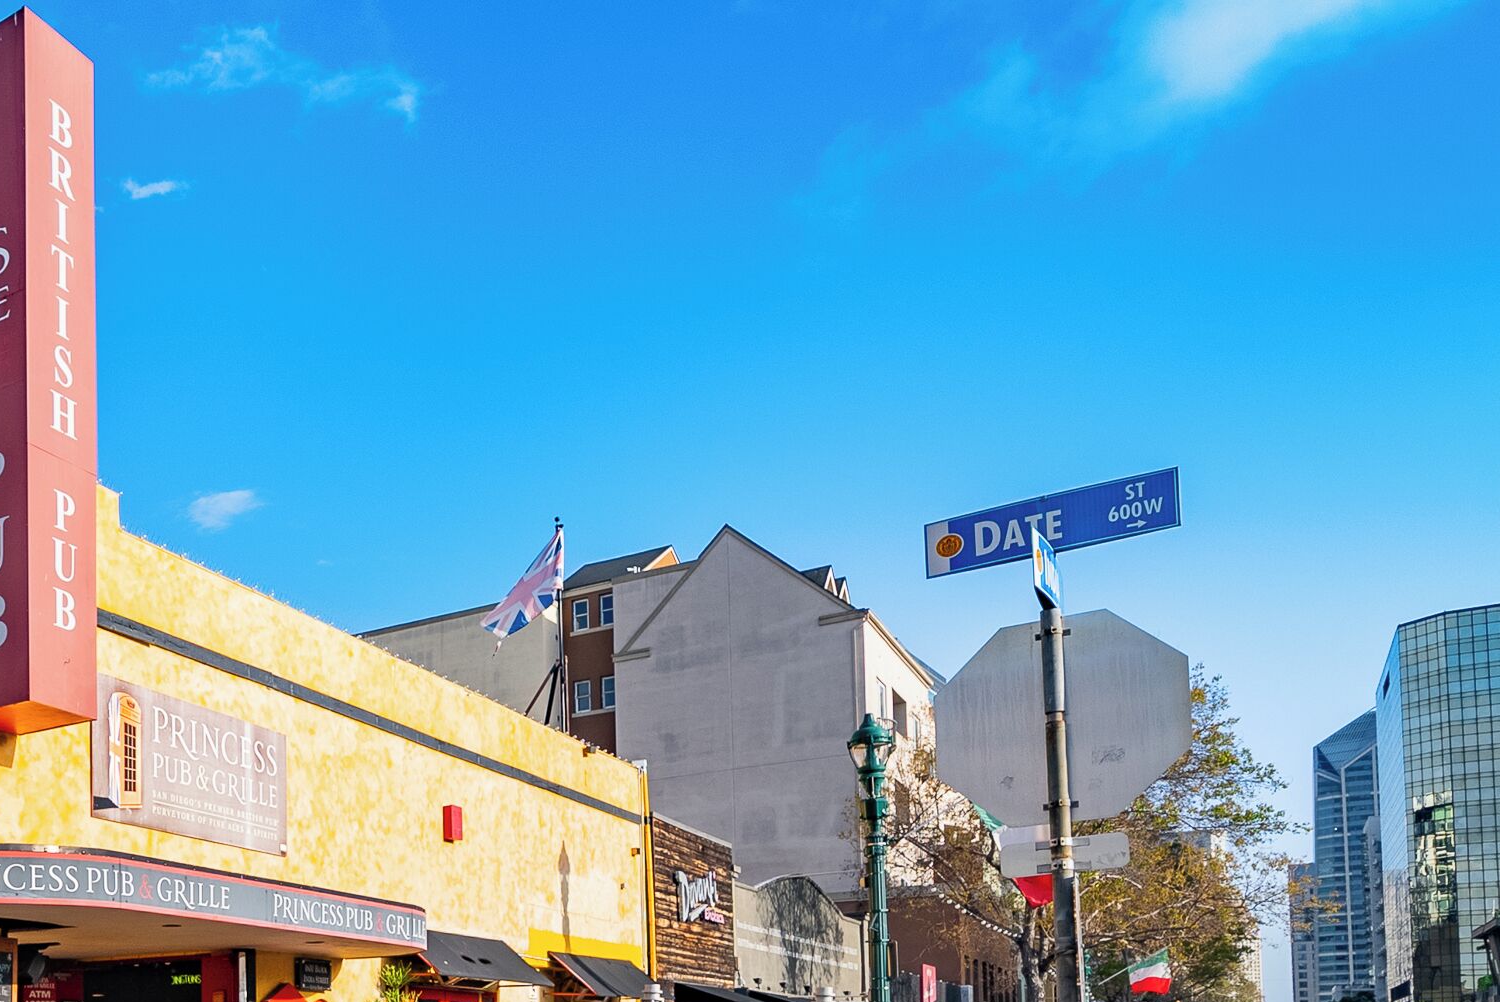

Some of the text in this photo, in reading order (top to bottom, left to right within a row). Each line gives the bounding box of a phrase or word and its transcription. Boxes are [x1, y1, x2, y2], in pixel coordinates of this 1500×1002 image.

[49, 99, 77, 441] BRITISH
[1125, 481, 1145, 501] ST
[974, 509, 1063, 557] DATE
[54, 489, 77, 631] PUB
[152, 706, 278, 777] PRINCESS
[152, 752, 278, 809] PUB & GRILLE
[152, 789, 167, 801] SAN
[170, 792, 202, 808] DIEGO'S
[152, 805, 195, 821] PURVEYORS
[197, 815, 207, 825] OF
[86, 867, 135, 897] PUB
[139, 874, 153, 899] &
[157, 876, 230, 911] GRILLE
[273, 893, 426, 940] PRINCESS PUB & GRILLE
[29, 990, 51, 998] ATM
